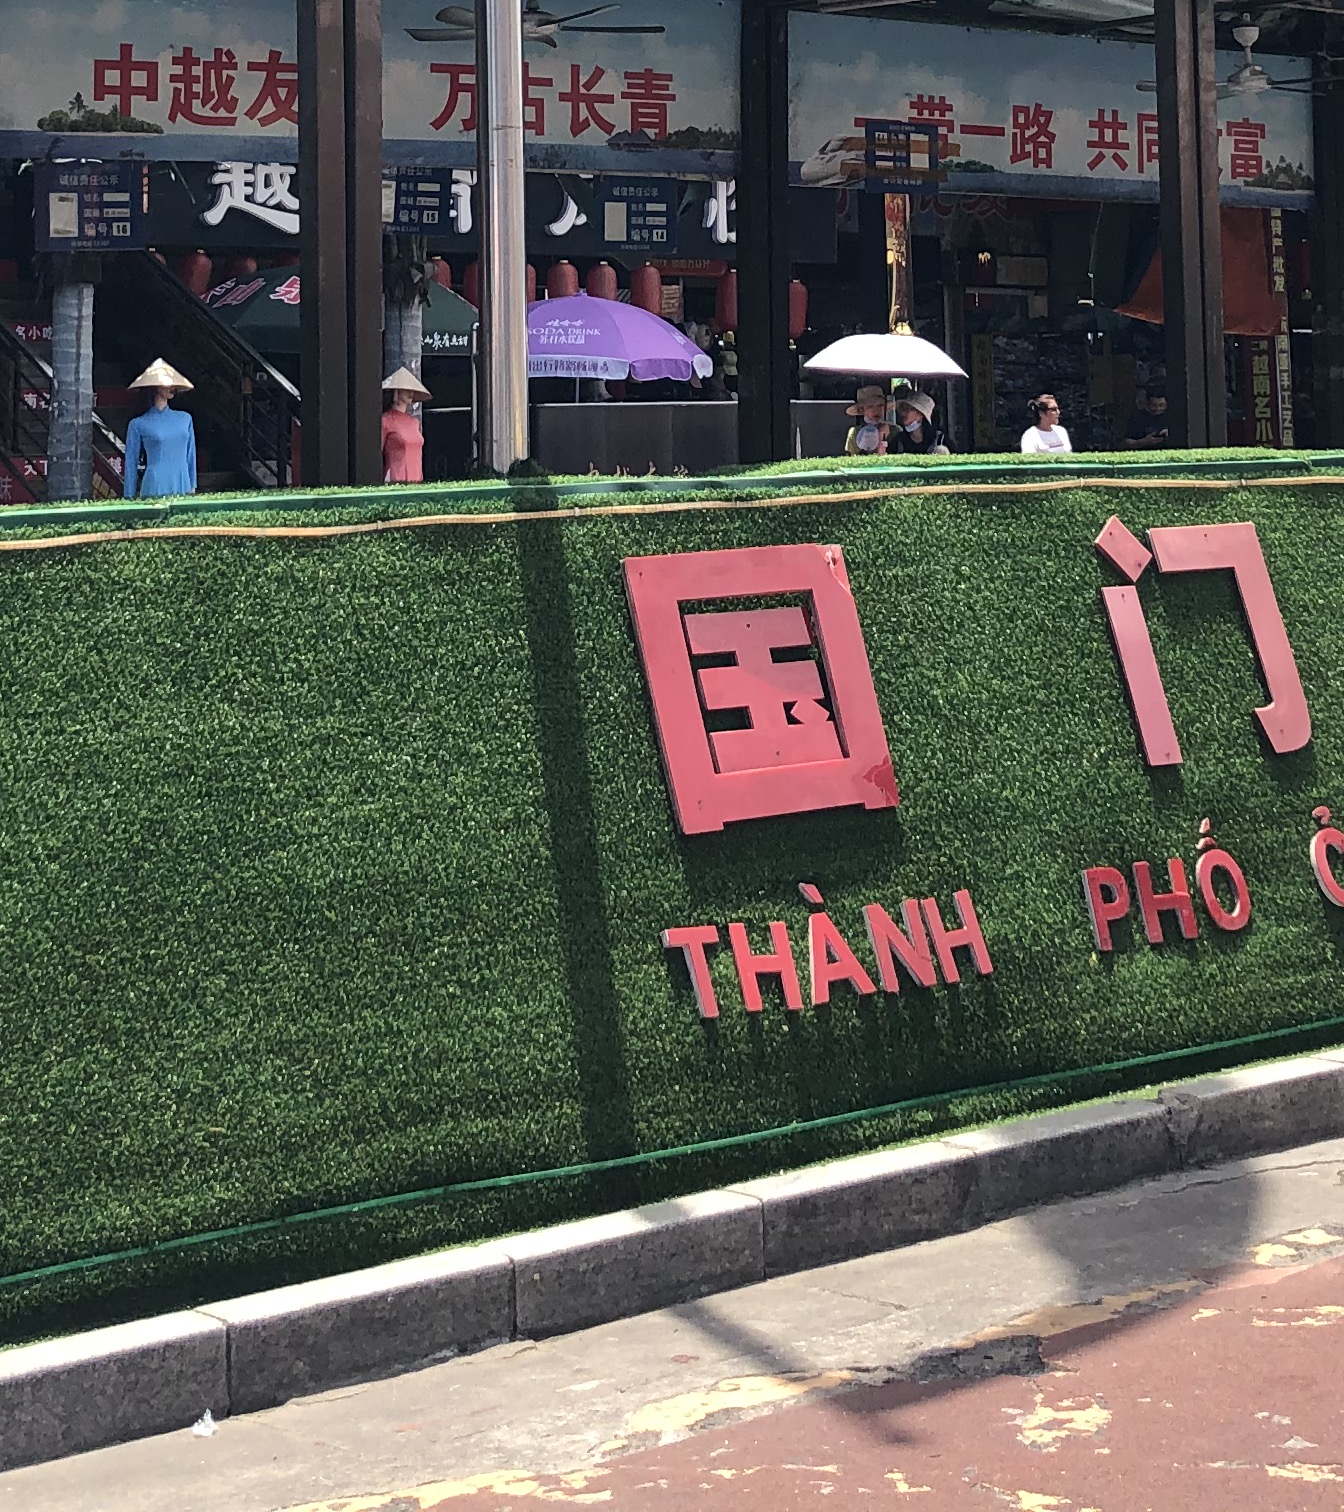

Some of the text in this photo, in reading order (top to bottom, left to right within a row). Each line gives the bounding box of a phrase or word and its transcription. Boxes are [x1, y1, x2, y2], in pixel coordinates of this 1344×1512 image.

[92, 43, 300, 130] 中越友
[1087, 107, 1266, 180] 共同富
[420, 332, 469, 350] 山泉有点甜
[567, 328, 601, 336] DRINK
[1251, 354, 1274, 446] 越南名小
[660, 882, 995, 1020] THÀNH
[1082, 816, 1253, 953] PHỐ
